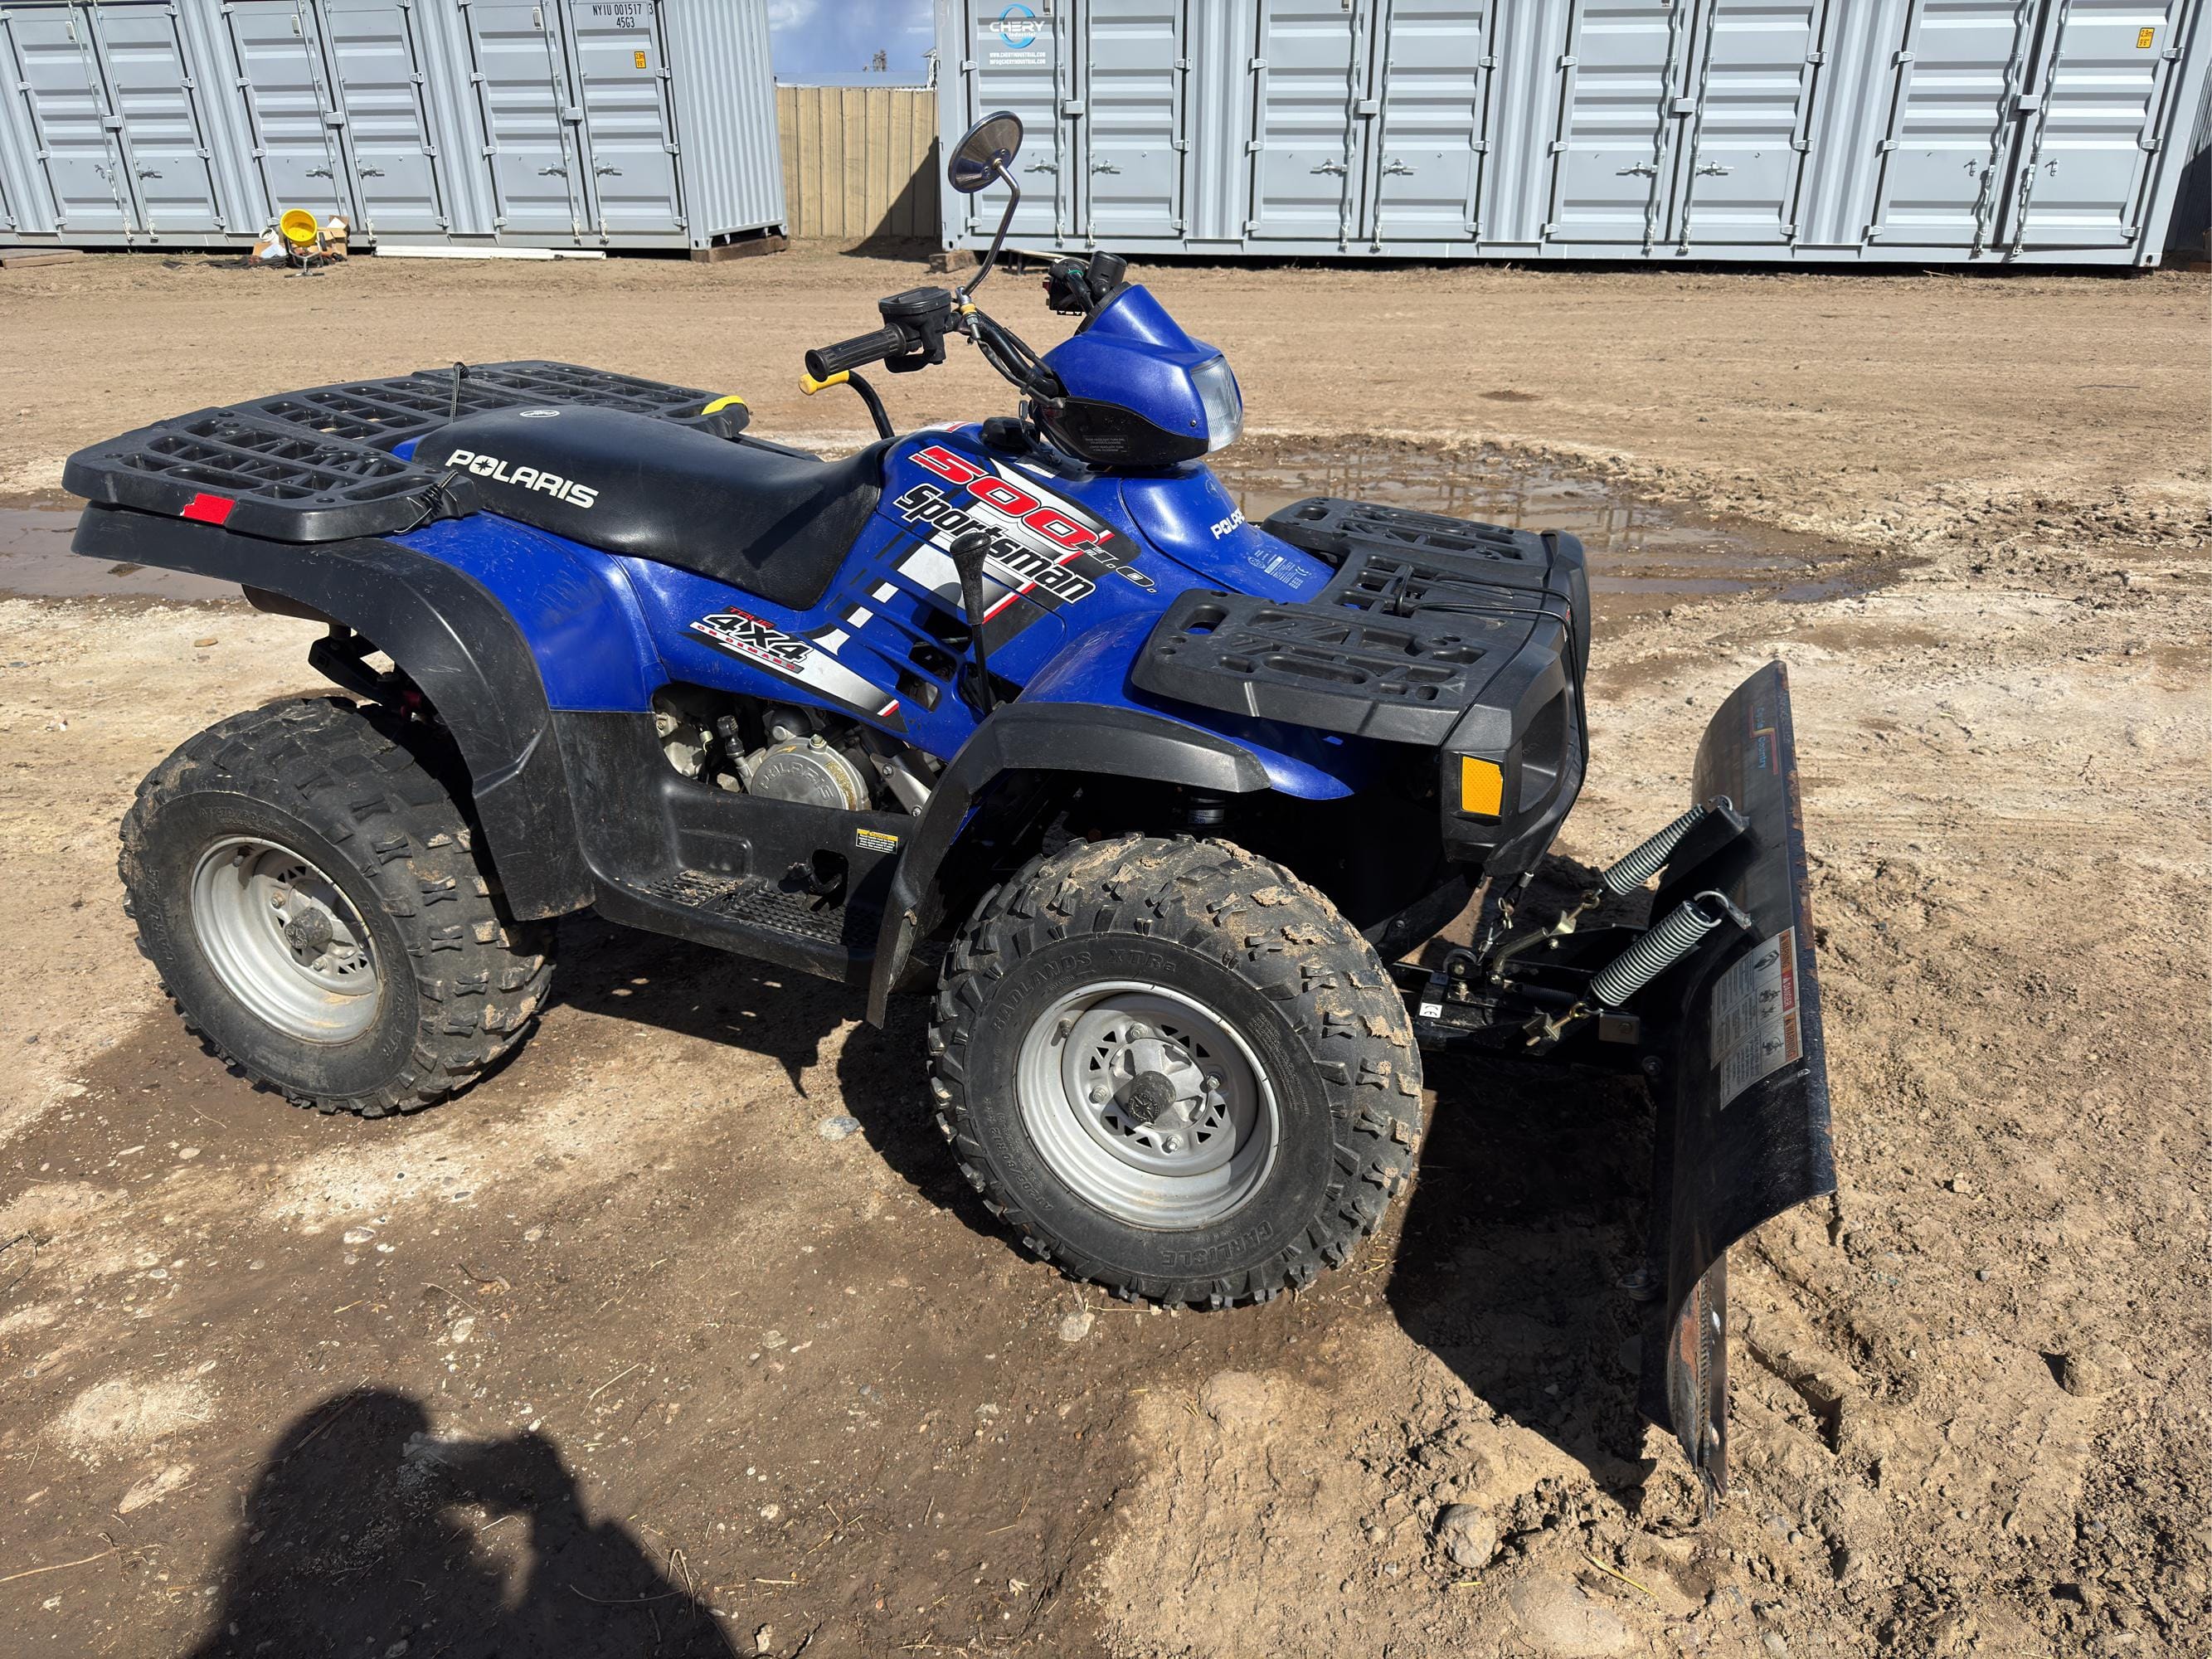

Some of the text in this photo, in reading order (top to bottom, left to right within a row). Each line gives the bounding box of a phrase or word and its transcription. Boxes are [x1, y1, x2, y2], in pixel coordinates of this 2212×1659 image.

[592, 3, 654, 16] NYIU 001517 3
[616, 17, 635, 28] 45G3
[989, 21, 1045, 32] CHERY
[445, 449, 599, 508] POLARIS
[907, 445, 1101, 552] 500
[892, 482, 1097, 605] Sportsman
[1210, 508, 1245, 540] POLAR
[1757, 736, 1767, 769] Country
[757, 761, 834, 801] POLARIS
[989, 951, 1092, 1034] BADLANDS
[1160, 1220, 1274, 1268] CARLISLE
